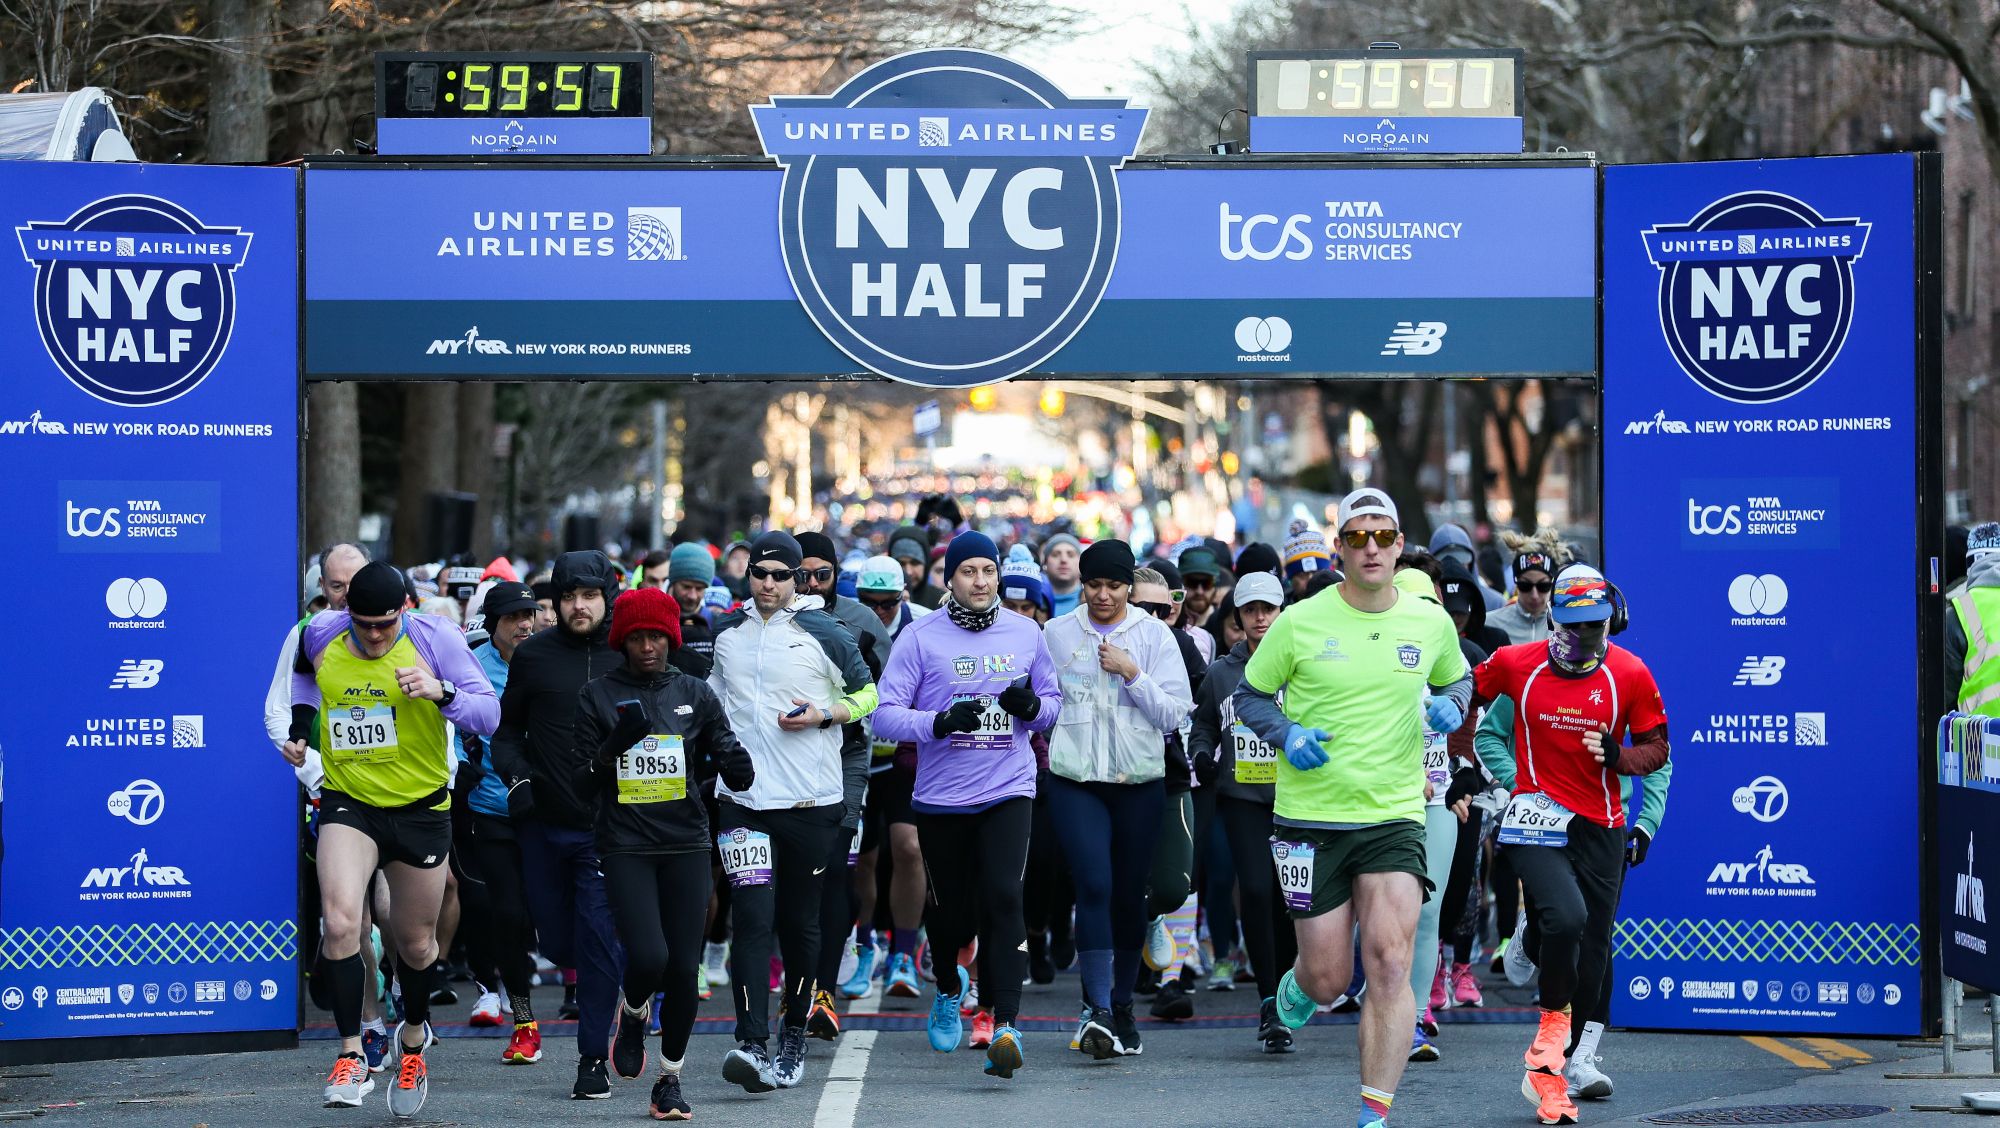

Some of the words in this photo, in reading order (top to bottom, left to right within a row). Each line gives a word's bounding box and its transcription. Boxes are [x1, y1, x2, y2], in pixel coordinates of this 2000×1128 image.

[784, 122, 910, 140] UNITED
[958, 123, 1116, 141] AIRLINES
[471, 134, 557, 146] NORQAIN
[1343, 133, 1429, 145] NORQAIN
[835, 167, 1064, 251] NYC
[1325, 201, 1384, 218] TATA
[474, 211, 614, 231] UNITED
[1219, 202, 1313, 261] tcs
[1325, 222, 1462, 239] CONSULTANCY
[37, 239, 112, 252] UNITED
[139, 242, 232, 255] AIRLINES
[437, 237, 616, 256] AIRLINES
[1661, 239, 1733, 252] UNITED
[1760, 235, 1851, 249] AIRLINES
[1325, 243, 1412, 261] SERVICES
[68, 267, 203, 322] NYC
[851, 263, 1046, 318] HALF
[1690, 263, 1822, 318] NYC
[77, 327, 193, 363] HALF
[1700, 323, 1812, 361] HALF
[516, 344, 548, 354] NEW
[550, 344, 587, 354] YORK
[590, 344, 627, 354] ROAD
[630, 344, 691, 354] RUNNERS
[73, 423, 109, 435] NEW
[113, 423, 154, 435] YORK
[157, 424, 199, 436] ROAD
[203, 424, 273, 437] RUNNERS
[1695, 421, 1729, 433] NEW
[1733, 420, 1773, 432] YORK
[1777, 419, 1818, 431] ROAD
[1823, 417, 1891, 431] RUNNERS
[127, 500, 161, 511] TATA
[1747, 497, 1781, 508] TATA
[66, 500, 121, 537] tcs
[127, 513, 207, 524] CONSULTANCY
[1688, 498, 1742, 536] tcs
[1747, 509, 1825, 521] CONSULTANCY
[127, 526, 178, 537] SERVICES
[1747, 523, 1797, 535] SERVICES
[1446, 583, 1460, 593] EY
[1401, 652, 1418, 660] NYC
[957, 661, 974, 670] NYC
[1556, 706, 1582, 715] Jianhui
[86, 718, 166, 731] UNITED
[982, 712, 1010, 731] 484
[1539, 713, 1561, 722] Misty
[1562, 715, 1598, 726] Mountain
[1710, 714, 1788, 728] UNITED
[333, 722, 343, 738] C
[347, 723, 386, 745] 8179
[1551, 722, 1586, 732] Runners
[66, 734, 166, 747] AIRLINES
[1691, 730, 1789, 743] AIRLINES
[1237, 736, 1246, 751] D
[620, 754, 629, 770] E
[635, 755, 678, 775] 9853
[109, 798, 130, 808] abc
[1733, 794, 1754, 804] abc
[1506, 803, 1517, 818] A
[727, 846, 768, 869] 19129
[80, 893, 100, 901] NEW
[101, 892, 125, 900] YORK
[126, 891, 150, 900] ROAD
[152, 890, 192, 899] RUNNERS
[1706, 888, 1726, 896] NEW
[1727, 888, 1751, 896] YORK
[1752, 888, 1776, 896] ROAD
[1777, 888, 1817, 897] RUNNERS
[57, 988, 86, 997] CENTRAL
[86, 987, 104, 997] PARK
[1682, 981, 1710, 990] CENTRAL
[1710, 981, 1728, 990] PARK
[1682, 989, 1728, 999] CONSERVANCY
[57, 996, 104, 1006] CONSERVANCY
